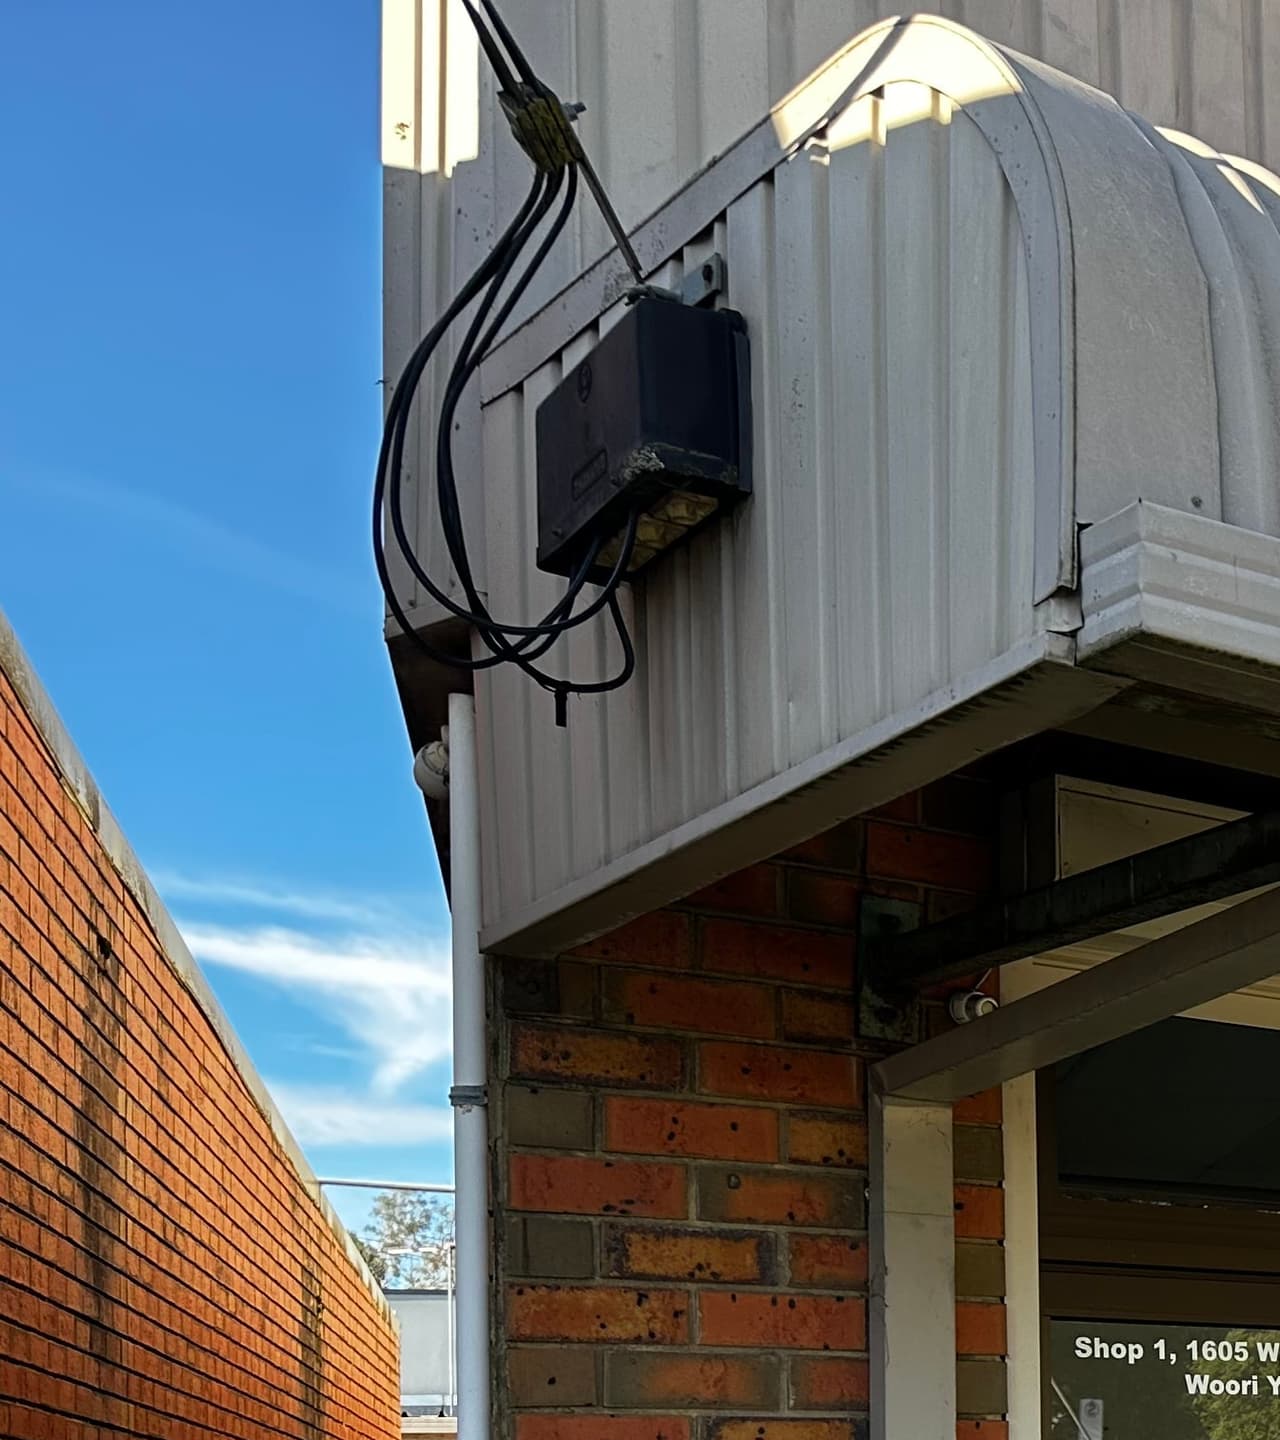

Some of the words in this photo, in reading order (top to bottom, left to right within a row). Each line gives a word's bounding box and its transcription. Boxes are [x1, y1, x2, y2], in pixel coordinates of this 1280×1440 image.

[1074, 1336, 1144, 1366] Shop
[1154, 1339, 1178, 1366] 1,
[1186, 1340, 1249, 1363] 1605
[1184, 1373, 1260, 1397] Woori
